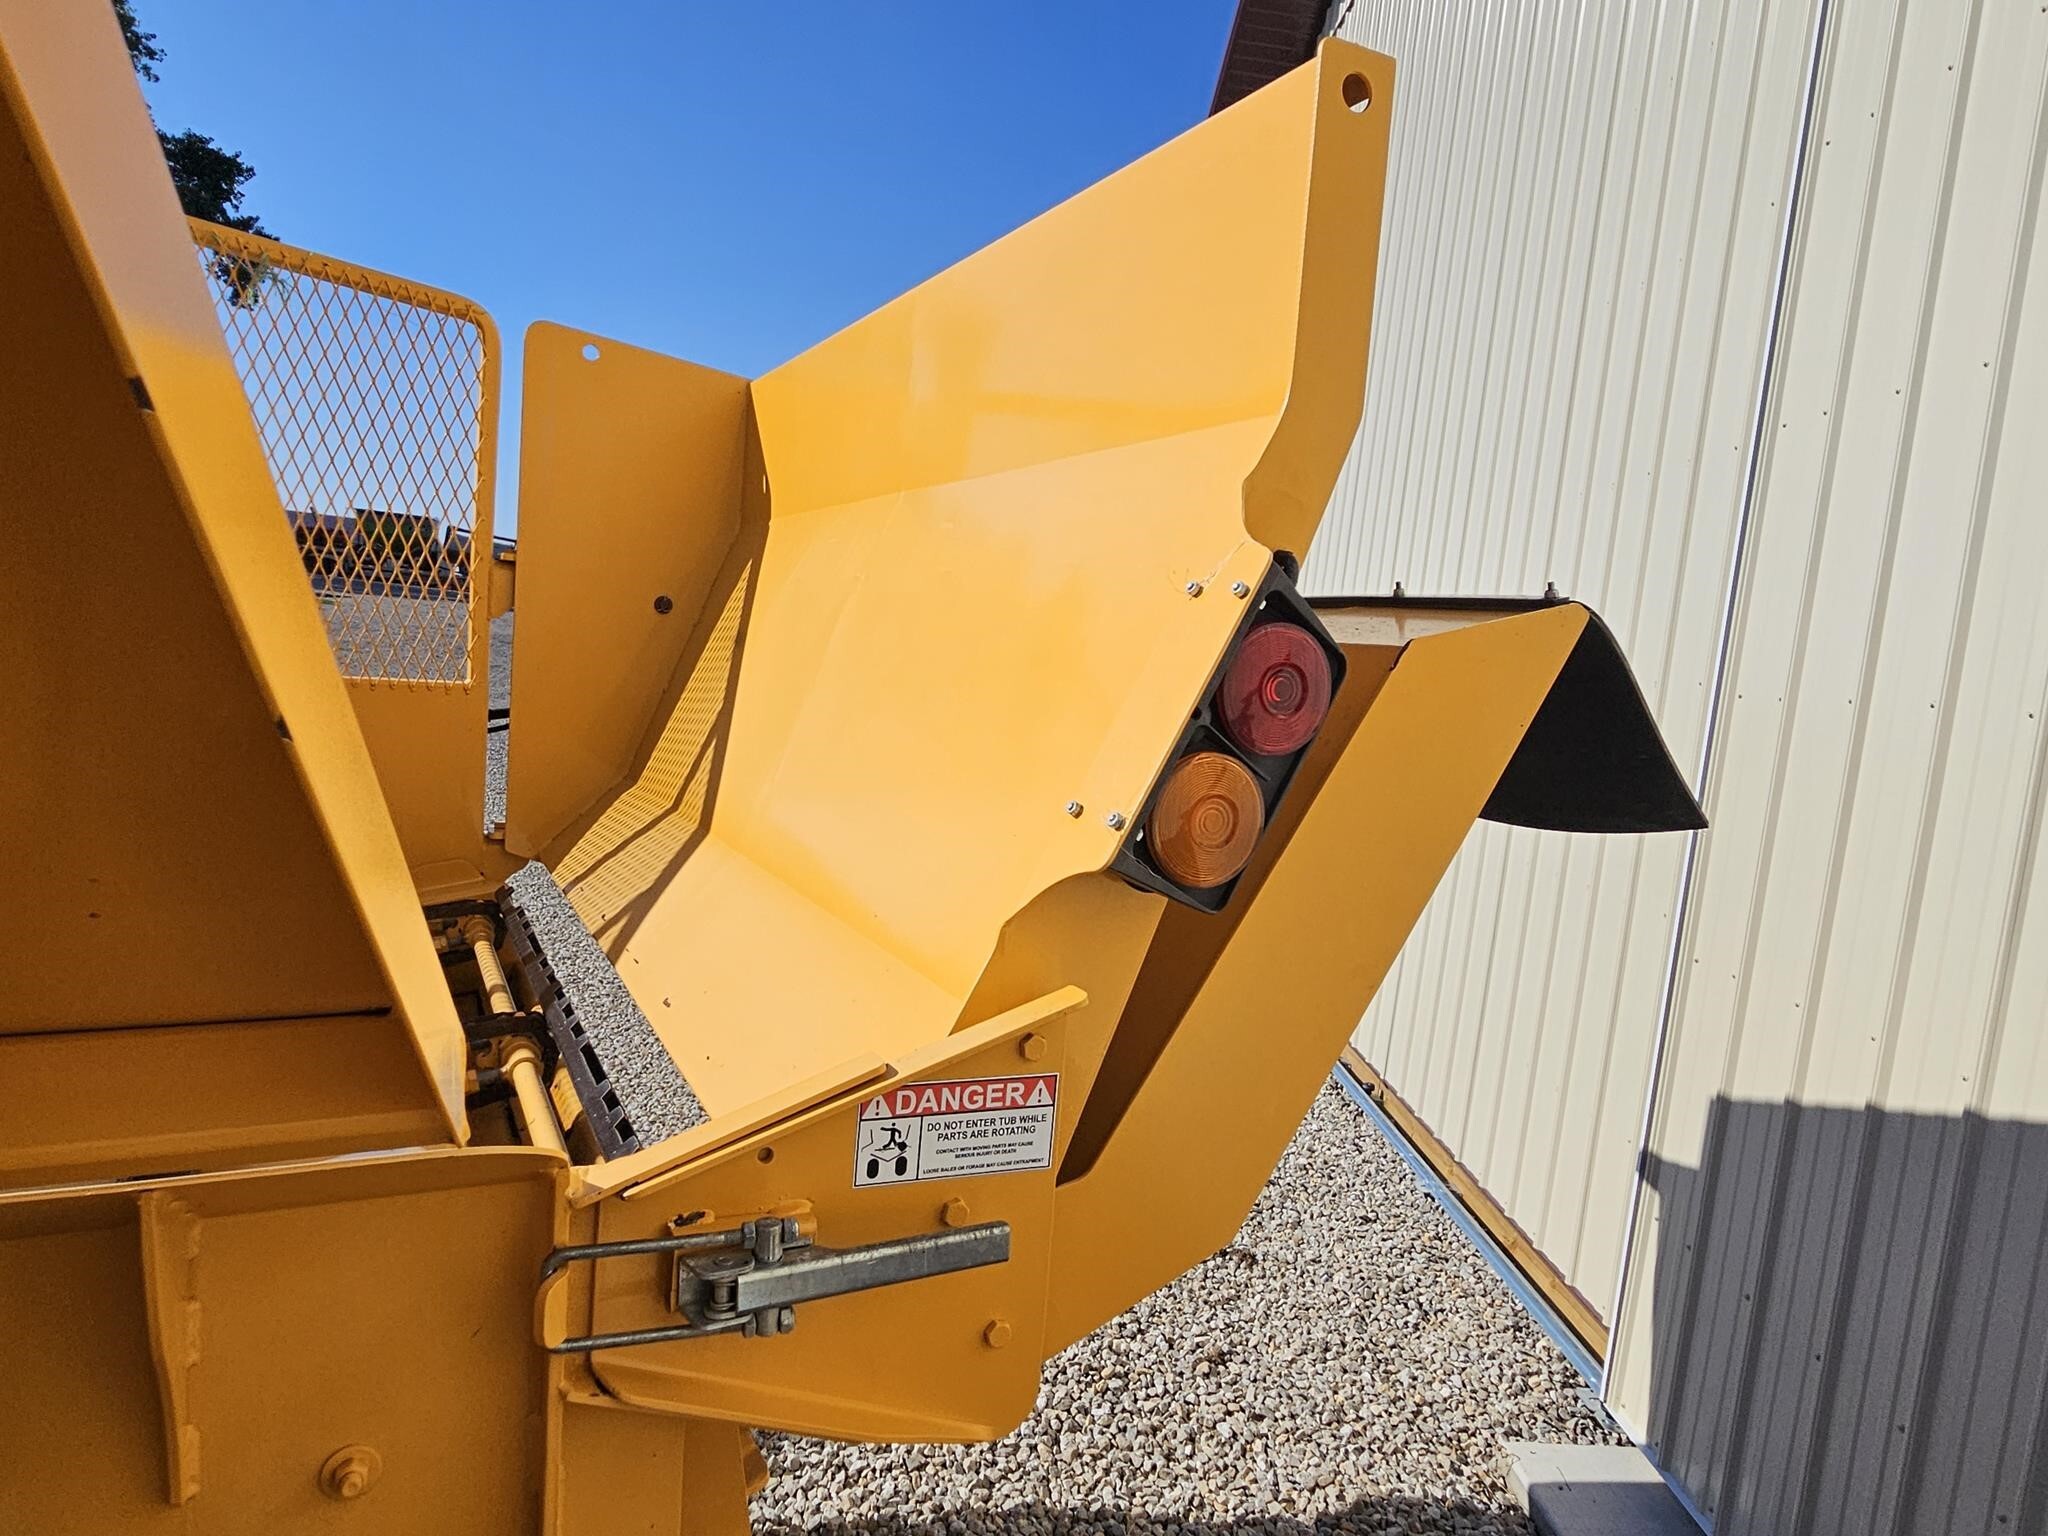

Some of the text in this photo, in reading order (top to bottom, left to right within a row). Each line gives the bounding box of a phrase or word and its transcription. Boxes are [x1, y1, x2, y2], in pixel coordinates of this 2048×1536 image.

[896, 1082, 1025, 1115] DANGER
[927, 1113, 1047, 1132] DO NOT ENTER TUB WHILE
[937, 1125, 1036, 1142] PARTS ARE ROTATING
[935, 1147, 959, 1155] CONTACT
[1013, 1157, 1044, 1165] ENTRAPMENT
